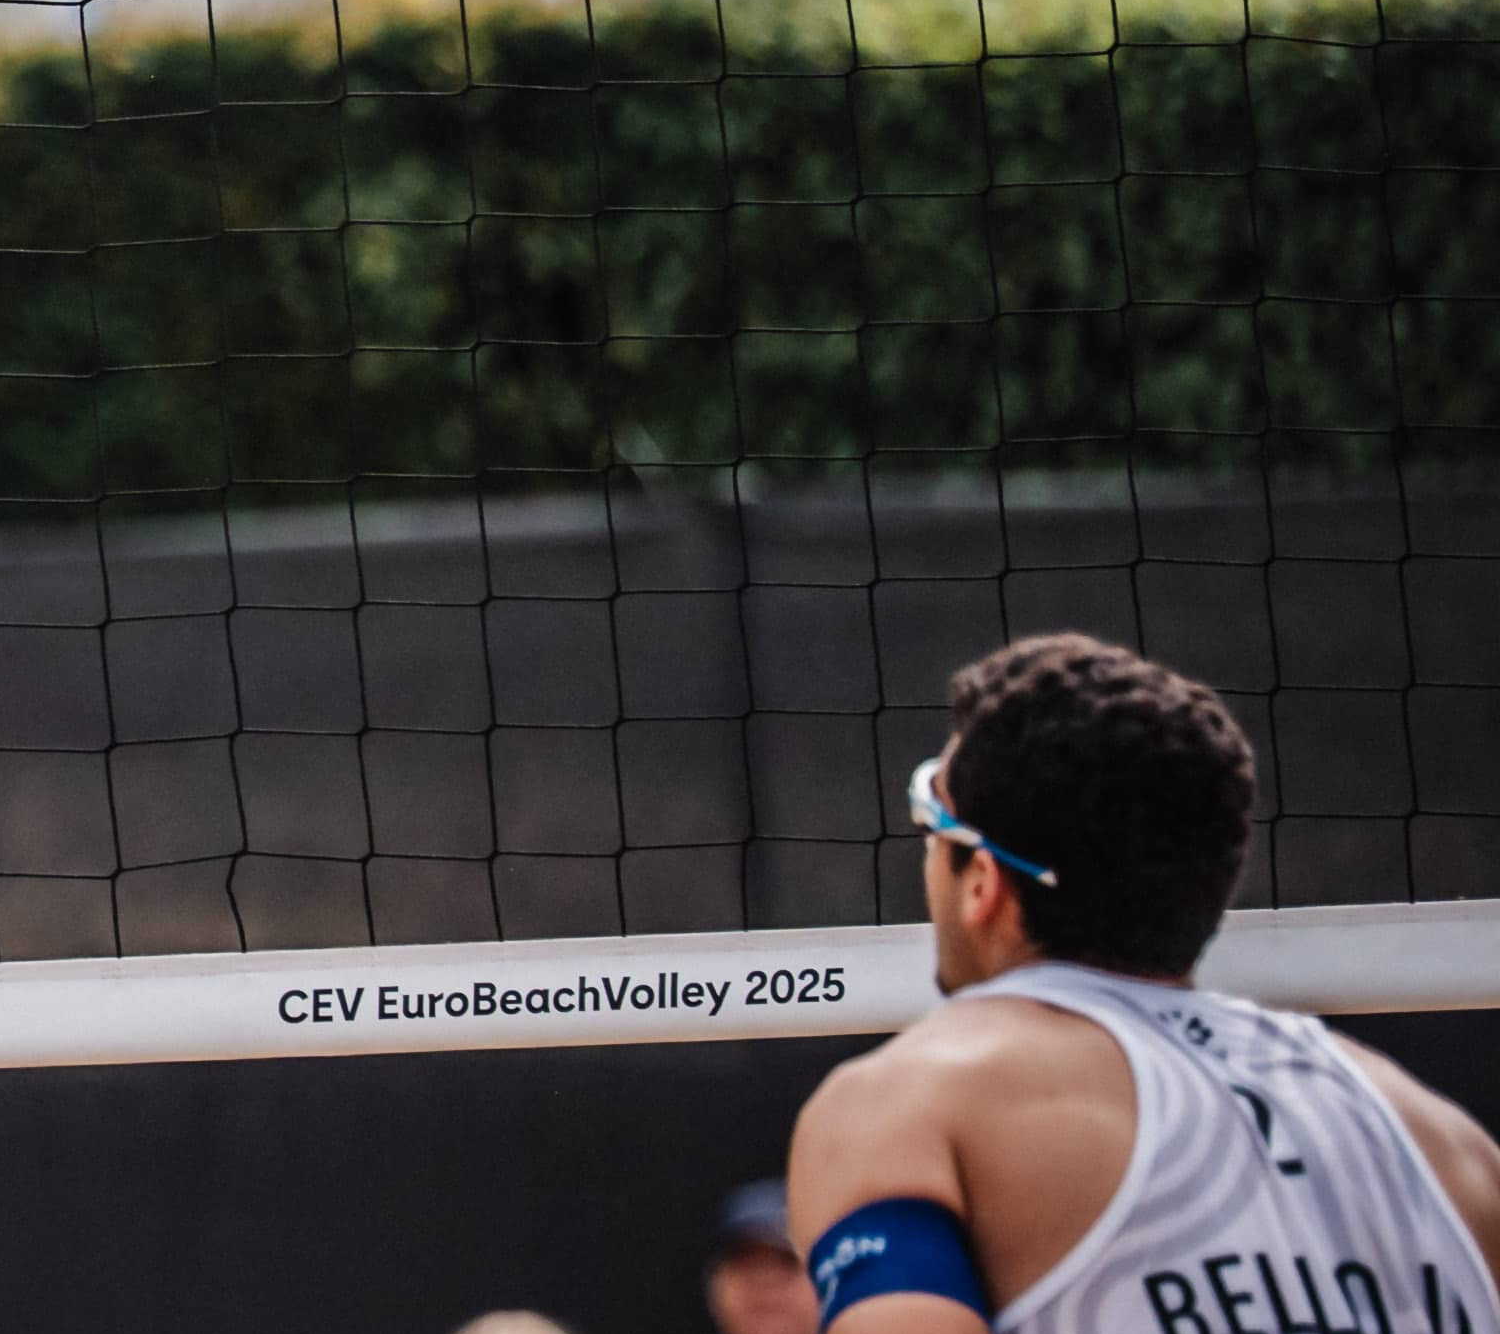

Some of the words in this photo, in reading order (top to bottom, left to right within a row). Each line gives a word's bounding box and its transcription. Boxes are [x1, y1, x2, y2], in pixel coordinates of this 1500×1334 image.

[277, 986, 365, 1024] CEV
[377, 972, 732, 1020] EuroBeachVolley
[743, 967, 846, 1007] 2025
